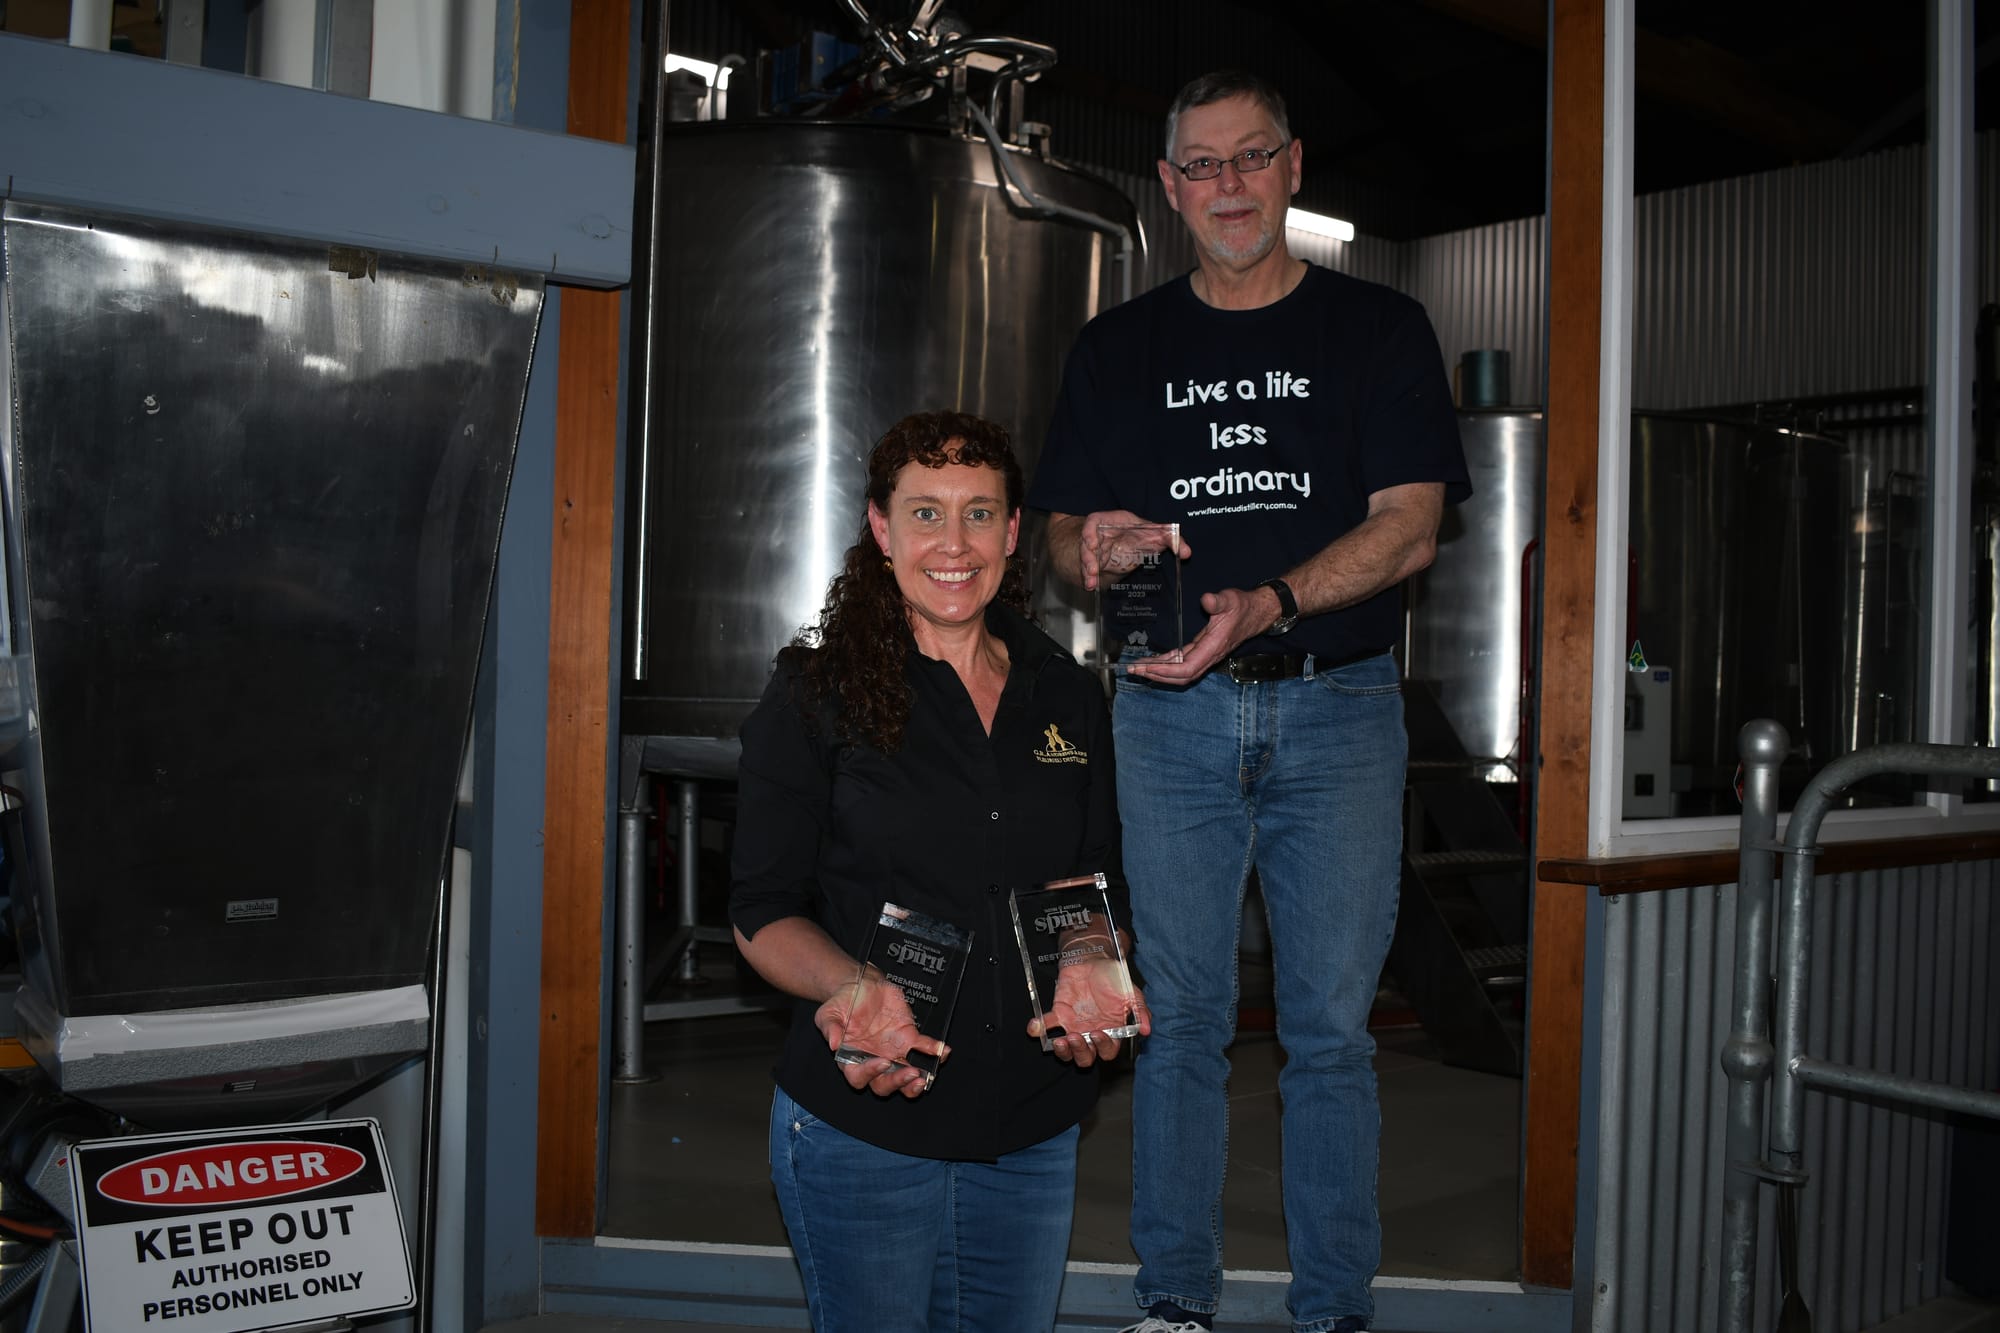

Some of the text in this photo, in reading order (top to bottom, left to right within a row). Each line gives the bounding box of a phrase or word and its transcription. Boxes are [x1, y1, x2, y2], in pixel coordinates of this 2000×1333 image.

[1166, 371, 1311, 408] Live a life
[1209, 422, 1268, 450] less
[1169, 467, 1311, 500] ordinary
[1187, 502, 1297, 517] www.fleurieudistillery.com.au
[1111, 583, 1162, 591] BEST WHISKY
[1034, 907, 1092, 934] spirit
[887, 942, 947, 972] spirit
[1038, 945, 1105, 963] BEST DISTILLER
[886, 973, 933, 993] PREMIER'S
[905, 988, 940, 1004] AWARD
[140, 1150, 331, 1197] DANGER
[134, 1204, 354, 1263] KEEP OUT
[171, 1250, 332, 1289] AUTHORISED
[143, 1271, 364, 1322] PERSONNEL ONLY
